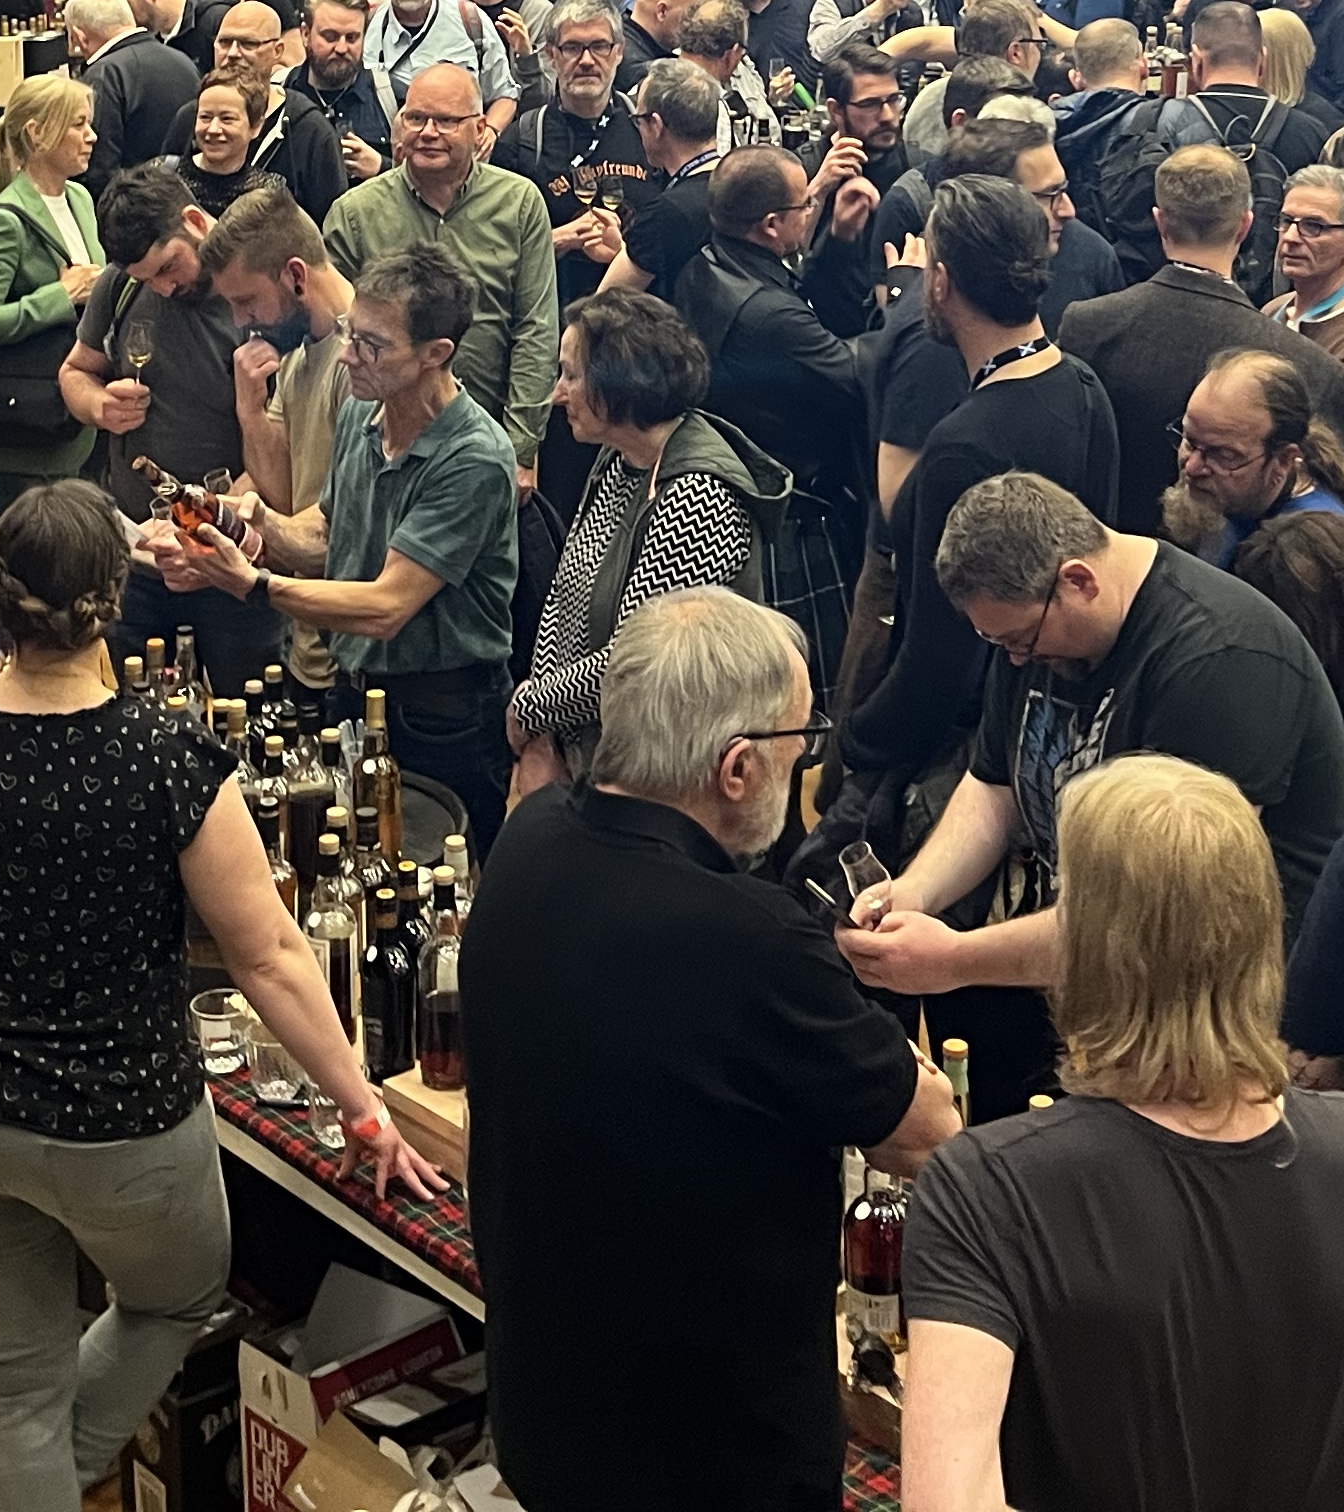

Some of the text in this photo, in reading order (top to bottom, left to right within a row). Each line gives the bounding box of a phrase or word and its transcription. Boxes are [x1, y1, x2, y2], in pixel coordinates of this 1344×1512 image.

[250, 1418, 289, 1469] DUB
[252, 1445, 282, 1490] LIN
[253, 1467, 276, 1511] ER
